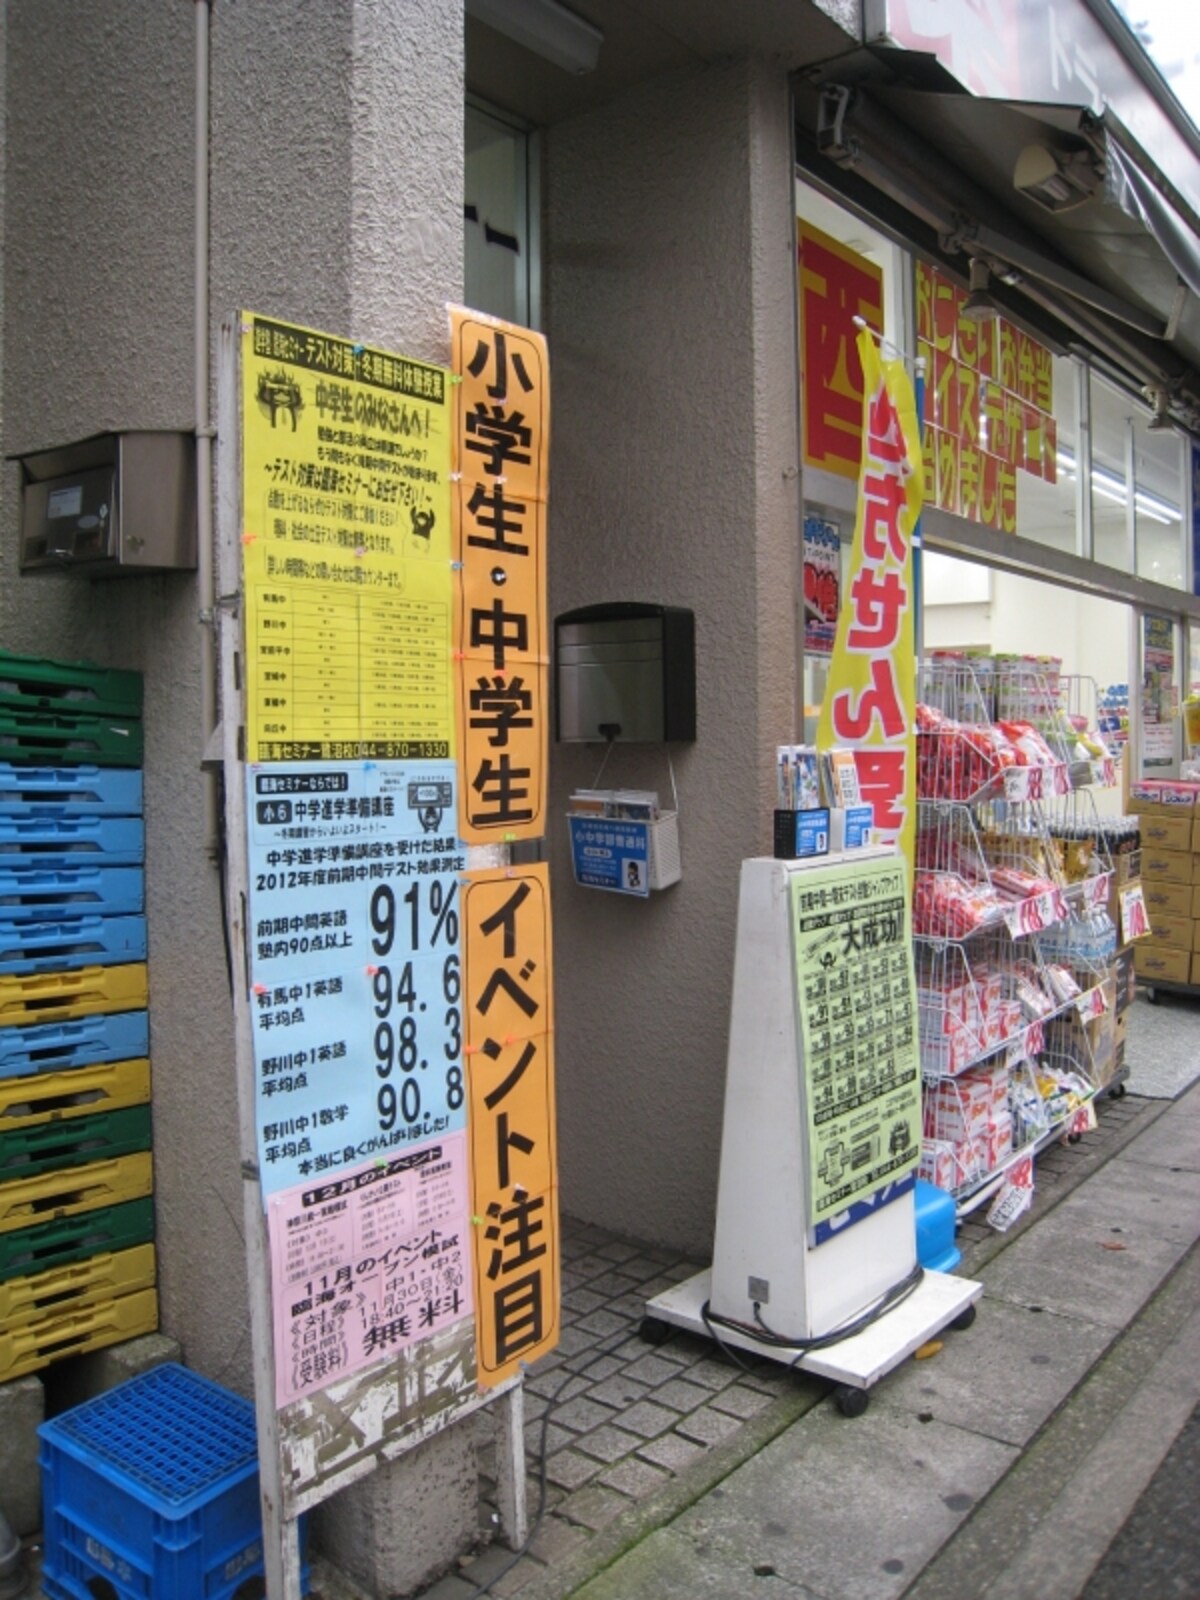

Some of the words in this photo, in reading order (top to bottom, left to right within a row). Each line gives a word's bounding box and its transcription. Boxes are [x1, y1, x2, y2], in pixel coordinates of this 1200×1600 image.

[465, 332, 534, 826] 小学生・中学生
[267, 837, 456, 867] 中学進学準備講座を受けた結果
[256, 856, 465, 891] 2012年度前期中間テスト効果測定
[257, 910, 347, 937] 前期中間英語
[370, 879, 459, 956] 91%
[258, 932, 353, 960] 塾内90点以上
[259, 1008, 305, 1031] 平均点
[261, 1040, 347, 1077] 野川中1英語
[262, 1072, 308, 1097] 平均点
[263, 1104, 349, 1143] 野川中1数学
[476, 881, 547, 1367] イベント注目
[265, 1137, 312, 1164] 平均点
[291, 1234, 459, 1317] 臨海オープン模試
[304, 1229, 442, 1296] 11月のイベント
[363, 1290, 463, 1357] 無料
